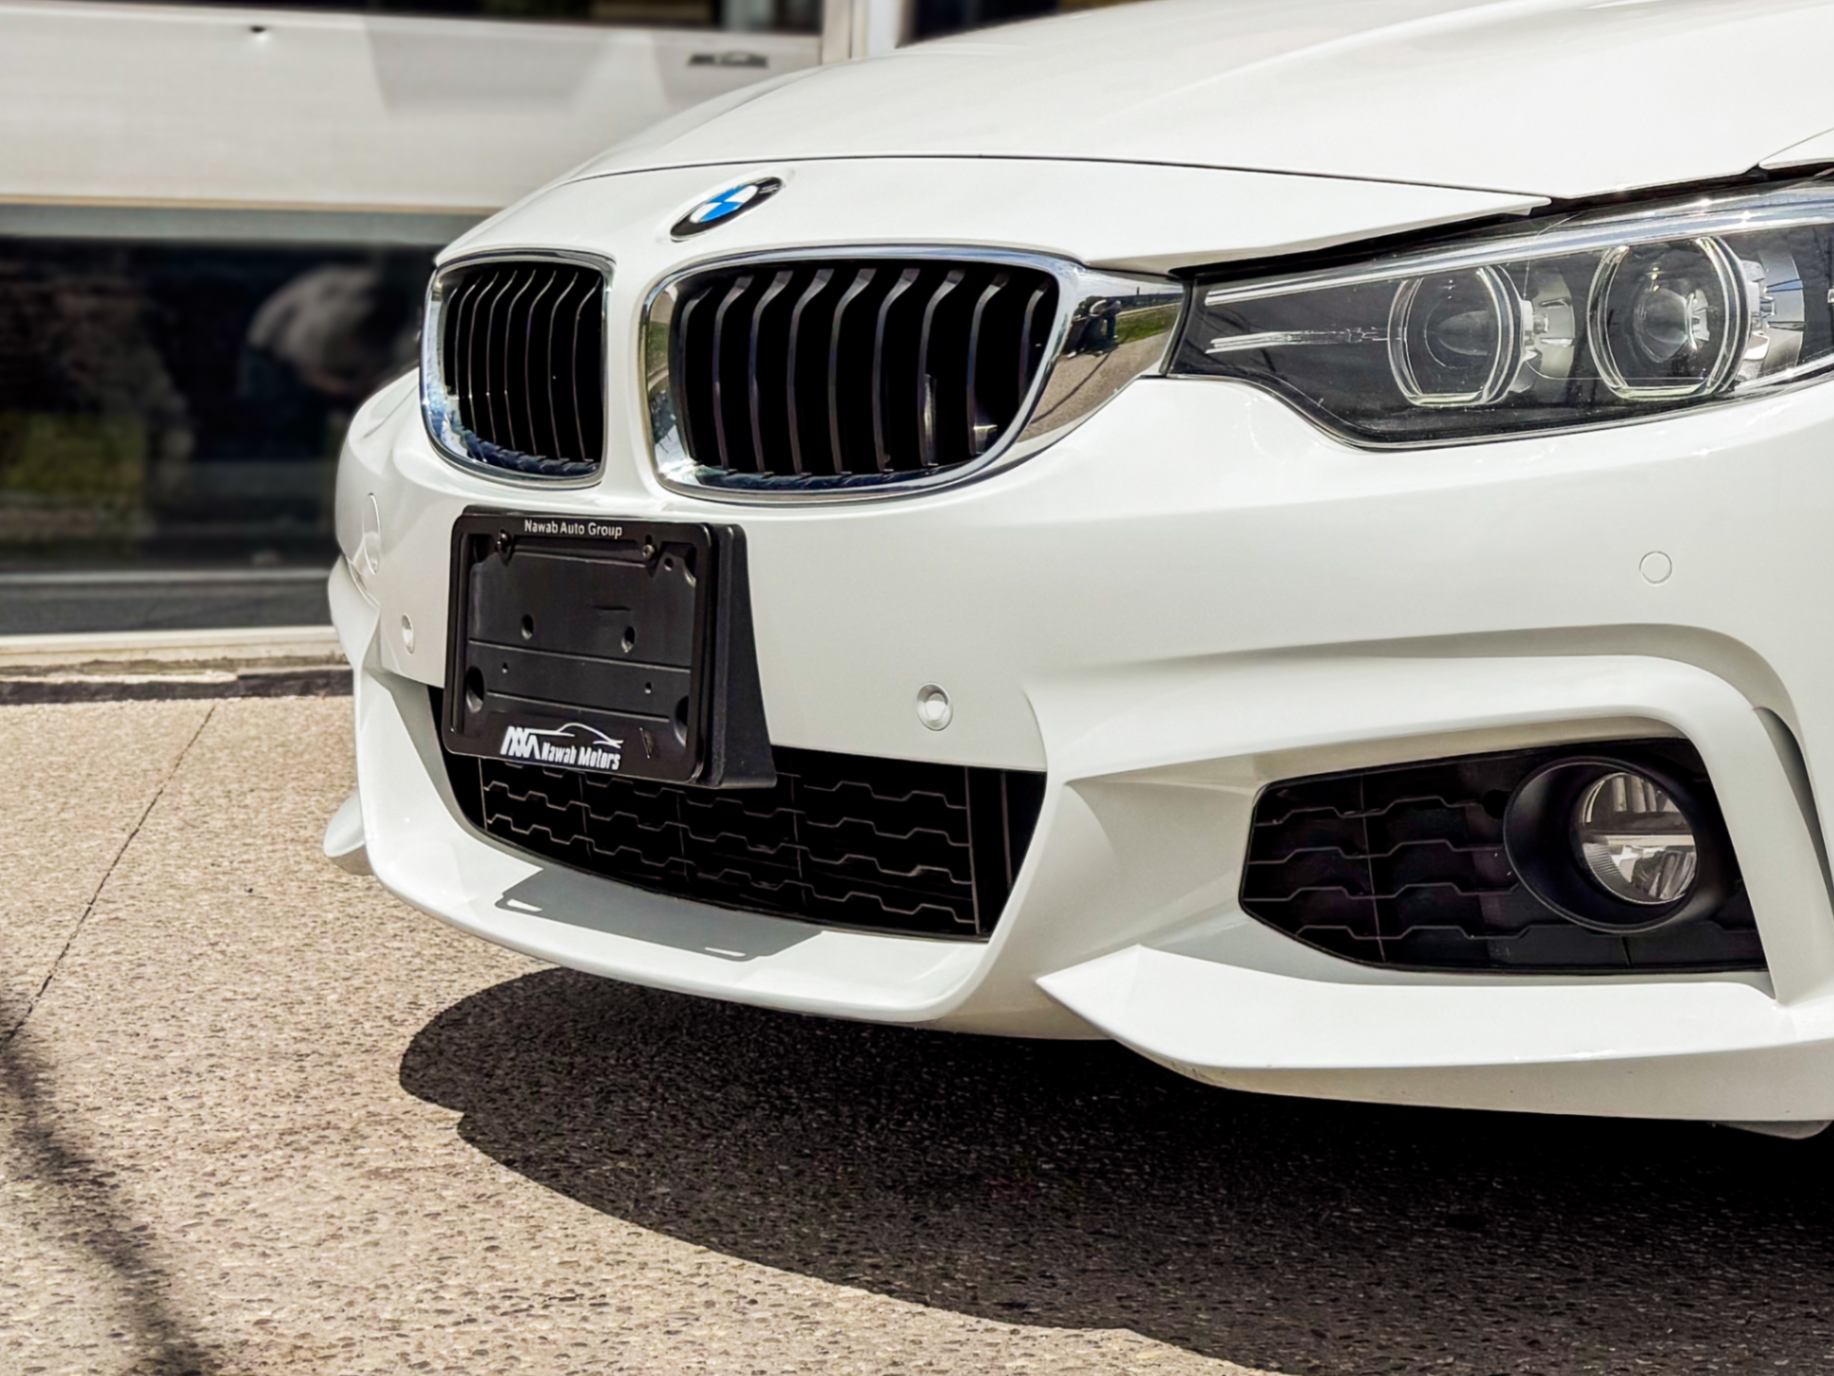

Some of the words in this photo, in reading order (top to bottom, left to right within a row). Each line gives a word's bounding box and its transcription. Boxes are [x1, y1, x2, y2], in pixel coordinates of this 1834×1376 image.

[524, 519, 559, 534] Nawab
[560, 522, 585, 535] Auto
[588, 522, 623, 540] Group
[541, 741, 577, 765] Nawab
[577, 745, 621, 771] Motors
